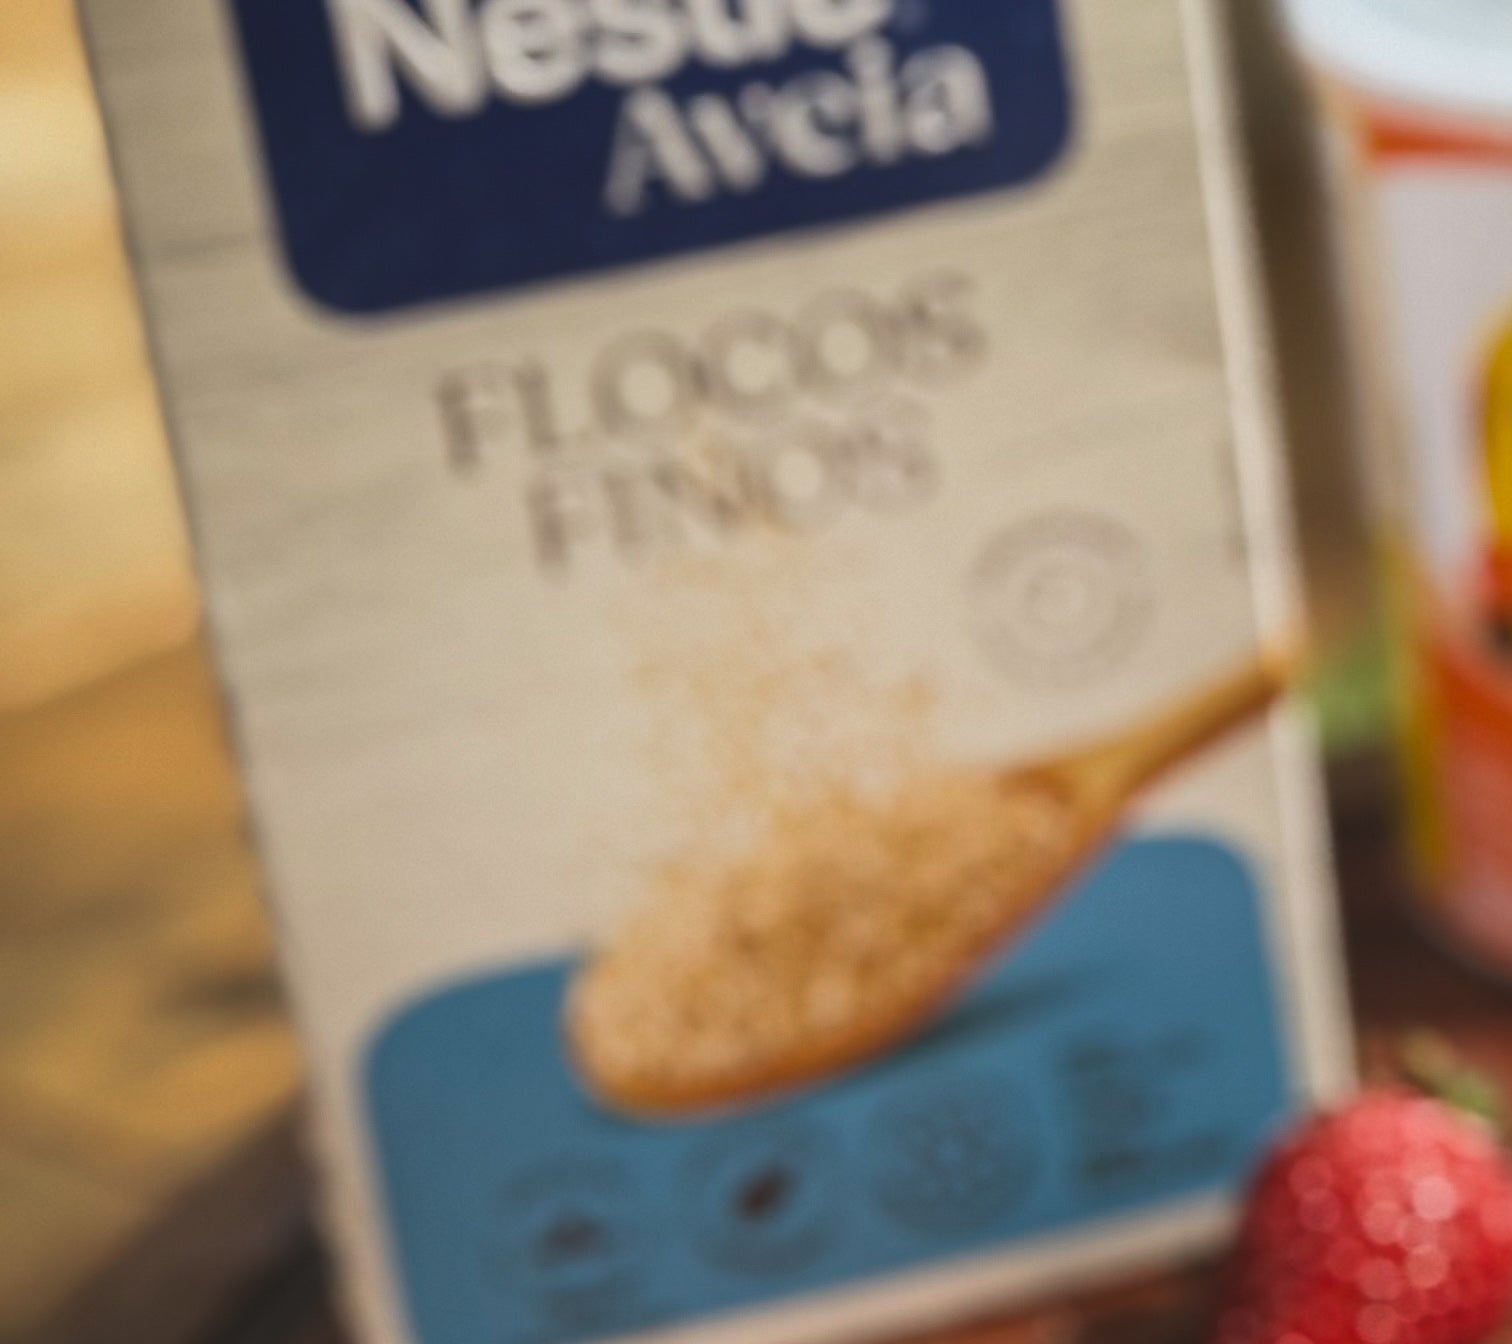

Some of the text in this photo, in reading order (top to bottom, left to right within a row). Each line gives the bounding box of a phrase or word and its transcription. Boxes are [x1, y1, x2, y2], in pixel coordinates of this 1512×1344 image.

[602, 36, 992, 218] Aveia
[436, 268, 990, 478] FLOCOS
[524, 394, 940, 586] FINOS
